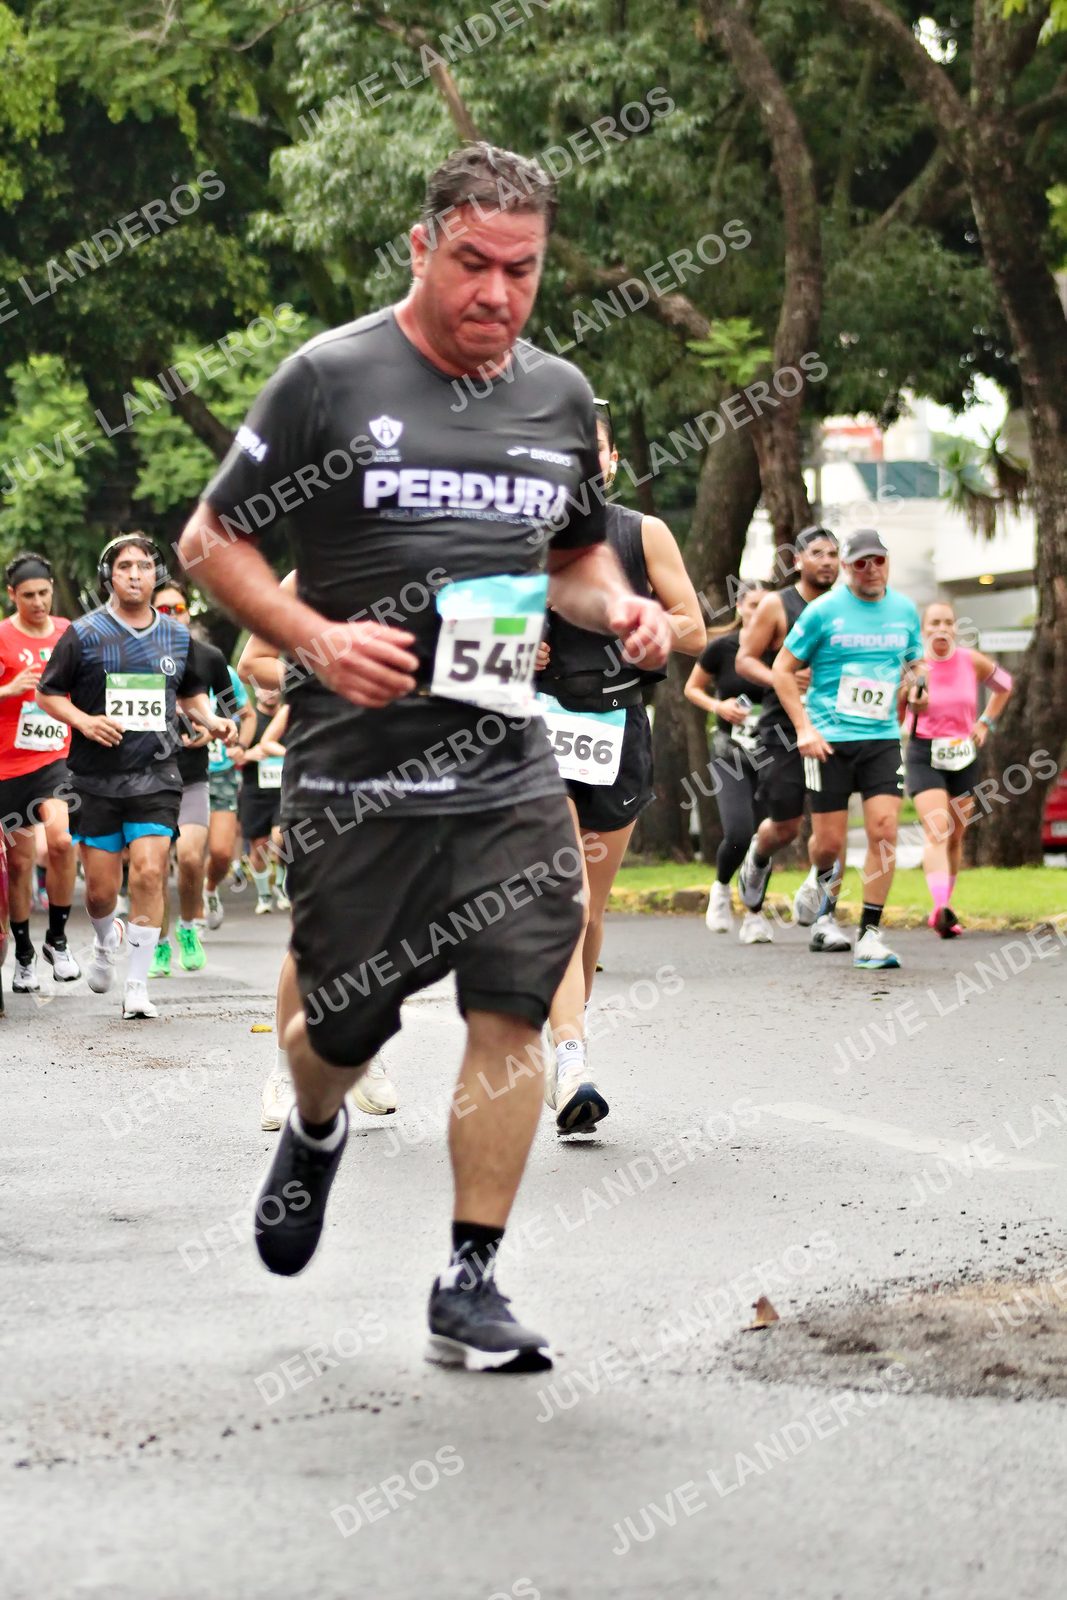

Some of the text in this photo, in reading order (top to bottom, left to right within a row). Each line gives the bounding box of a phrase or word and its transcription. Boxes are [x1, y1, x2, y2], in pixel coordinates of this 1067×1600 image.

[851, 688, 884, 706] 102
[110, 700, 161, 717] 2136
[22, 723, 64, 739] 5406
